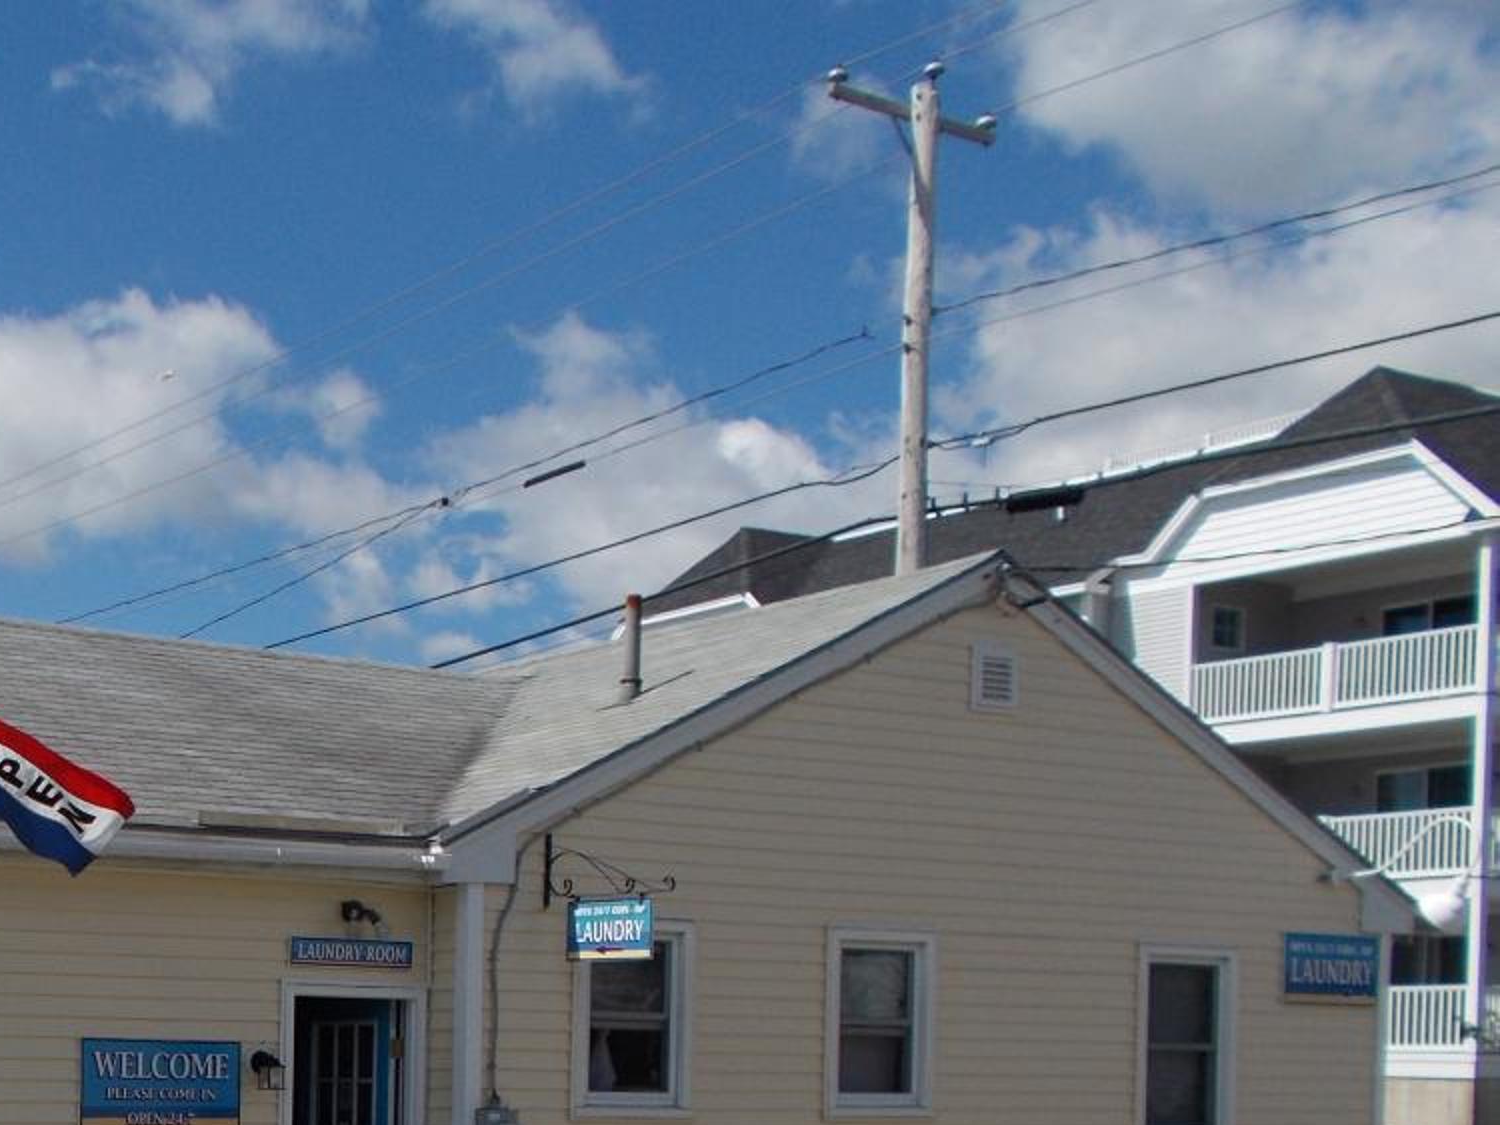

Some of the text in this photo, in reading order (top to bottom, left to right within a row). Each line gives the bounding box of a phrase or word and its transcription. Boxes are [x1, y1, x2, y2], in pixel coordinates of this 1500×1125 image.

[575, 919, 645, 943] LAUNDRY
[298, 943, 407, 963] LAUNDRY ROOM
[1290, 956, 1371, 987] LAUNDRY
[93, 1051, 229, 1079] WELCOME
[106, 1087, 154, 1100] PLEASE
[159, 1087, 198, 1100] COME
